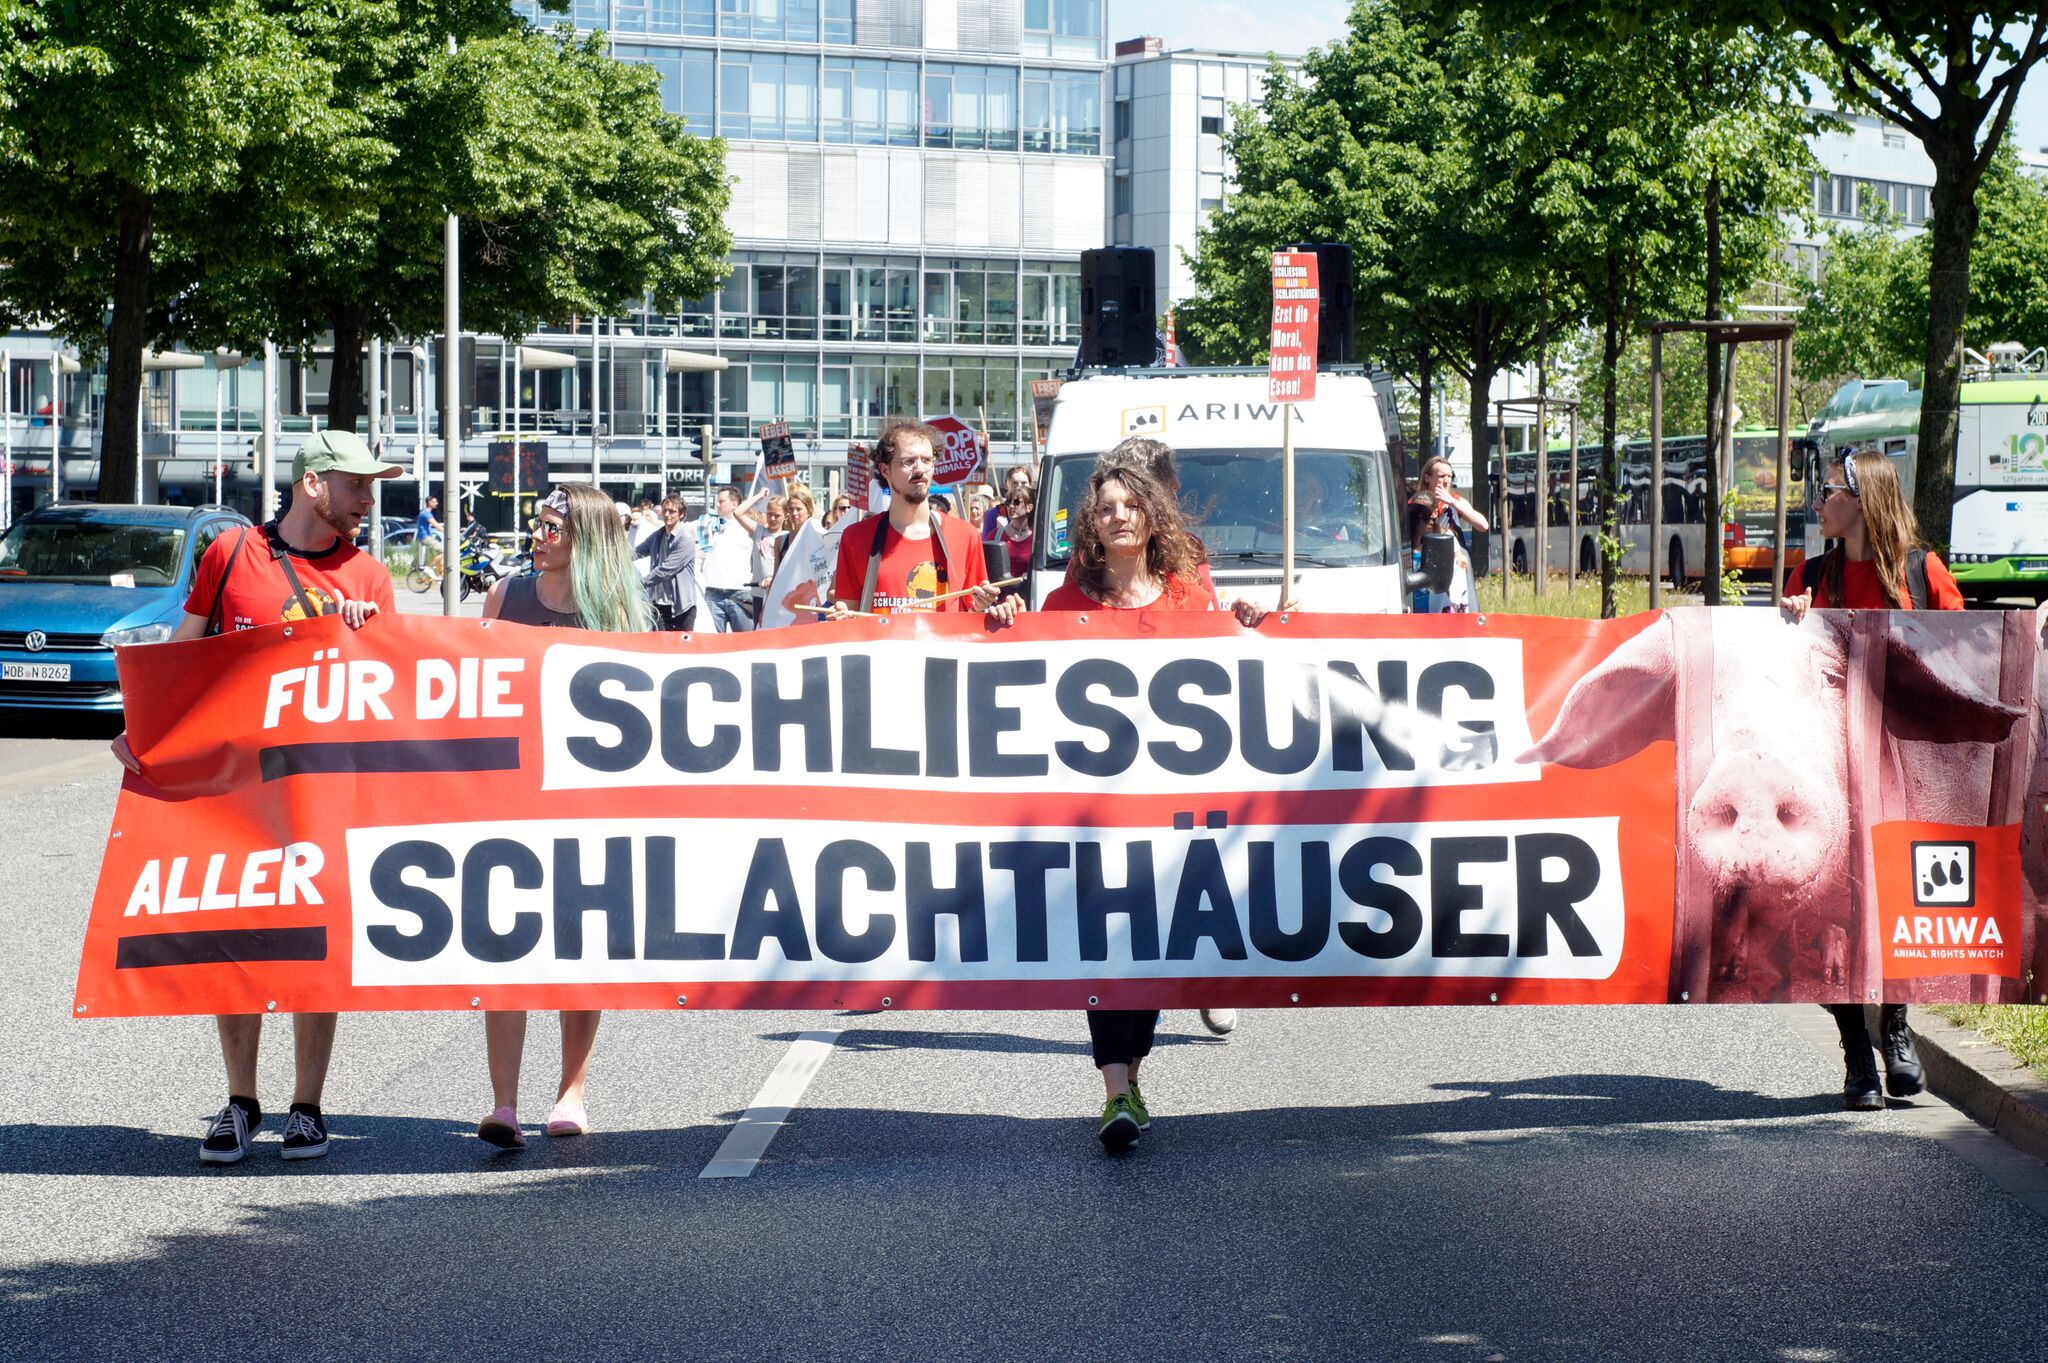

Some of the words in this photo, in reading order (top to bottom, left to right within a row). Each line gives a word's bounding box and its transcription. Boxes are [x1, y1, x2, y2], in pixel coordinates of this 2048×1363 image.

[1274, 305, 1293, 323] Erst
[1295, 304, 1308, 323] die
[1273, 329, 1302, 349] Moral,
[1271, 354, 1294, 371] dann
[1297, 353, 1311, 371] das
[1270, 377, 1301, 396] Essen!
[1177, 403, 1305, 422] ARIWA
[761, 422, 788, 440] LEBEN
[944, 429, 973, 451] OP
[666, 468, 706, 483] TORH
[766, 461, 796, 476] LASSEN
[4, 665, 24, 678] WOB
[32, 666, 39, 678] N
[41, 667, 68, 679] 8262
[263, 648, 394, 729] FÜR
[416, 657, 525, 720] DIE
[566, 654, 1499, 778] SCHLIESSUNG
[123, 841, 325, 917] ALLER
[366, 810, 1602, 964] SCHLACHTHÄUSER
[1892, 916, 2003, 944] ARIWA
[1894, 948, 1928, 959] ANIMAL
[1931, 949, 1965, 959] RIGHTS
[1968, 949, 2004, 959] WATCH
